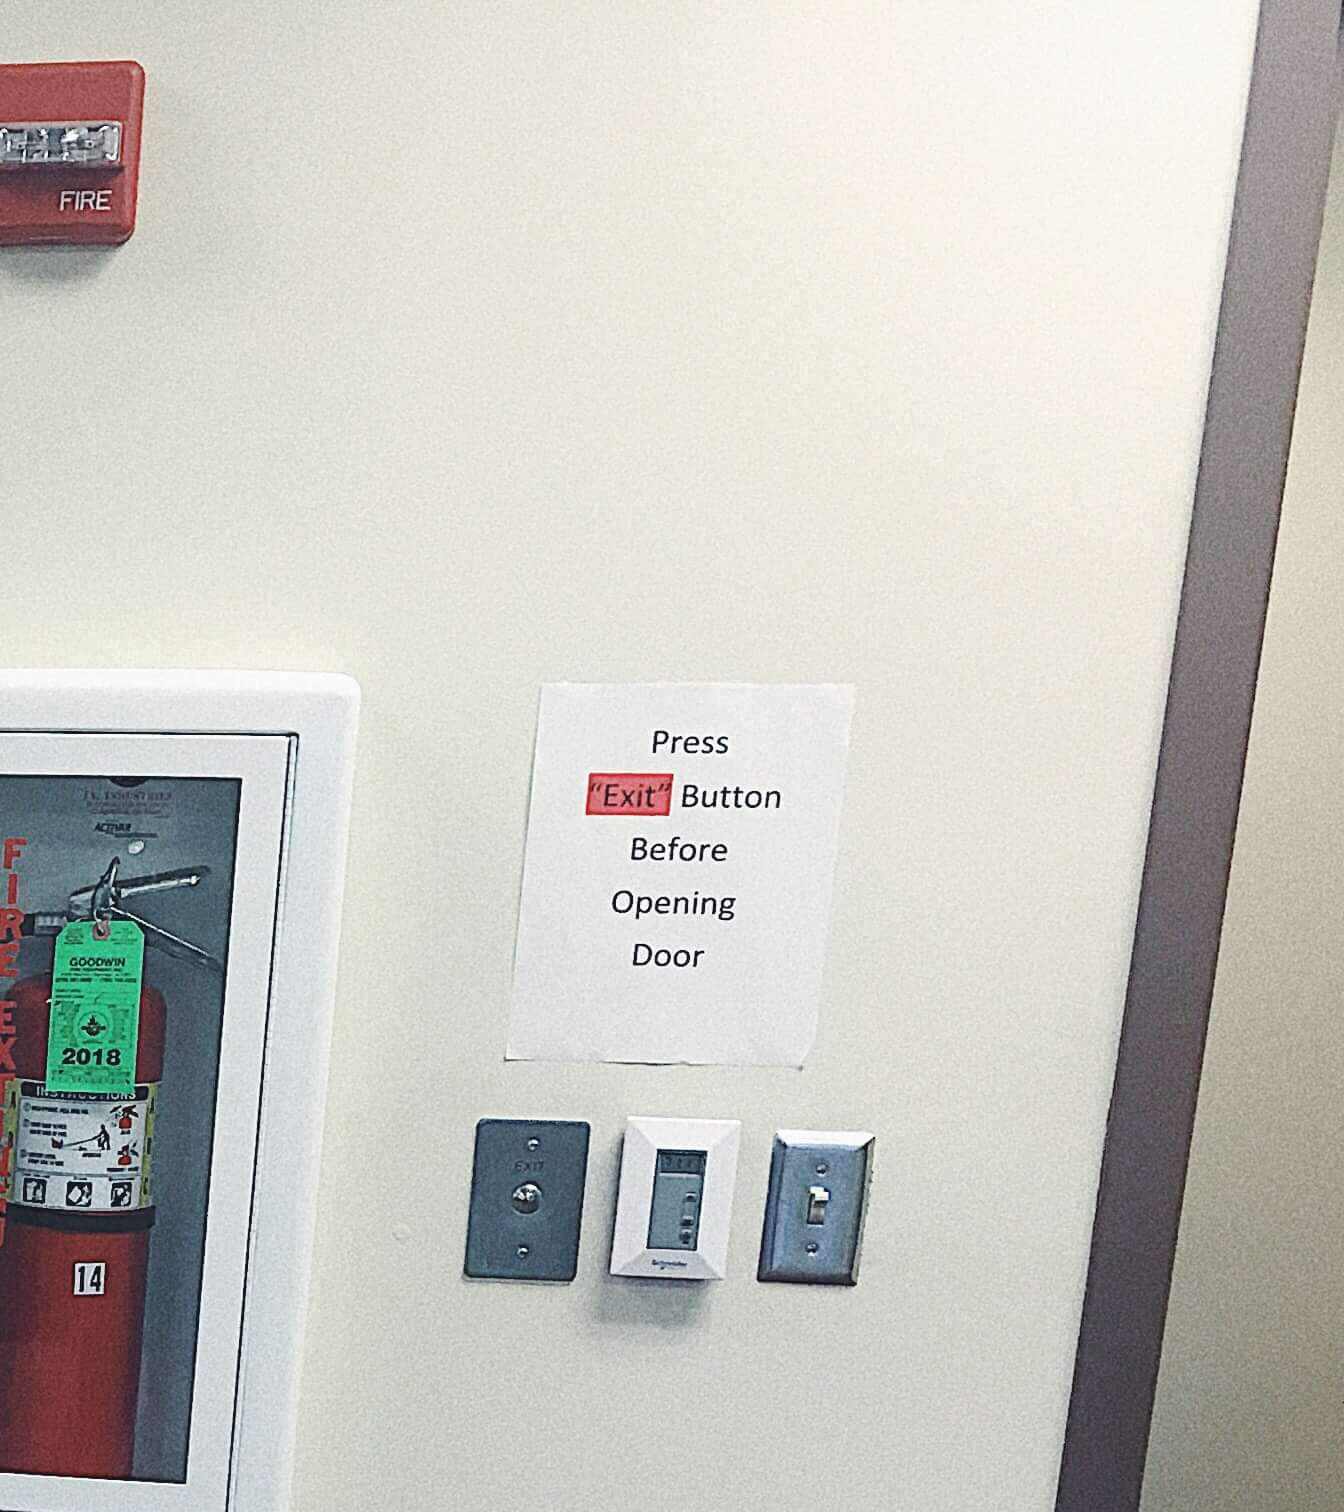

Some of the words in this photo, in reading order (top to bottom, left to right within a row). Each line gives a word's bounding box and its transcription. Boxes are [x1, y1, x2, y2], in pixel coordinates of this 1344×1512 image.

[59, 189, 113, 212] FIRE
[651, 730, 729, 755] Press
[681, 784, 781, 809] Button
[630, 836, 728, 862] Before
[611, 889, 737, 921] Opening
[69, 957, 126, 967] GOODWIN
[632, 942, 705, 968] Door
[62, 1047, 121, 1066] 2018
[514, 1160, 544, 1172] EXIT
[76, 1265, 102, 1292] 14
